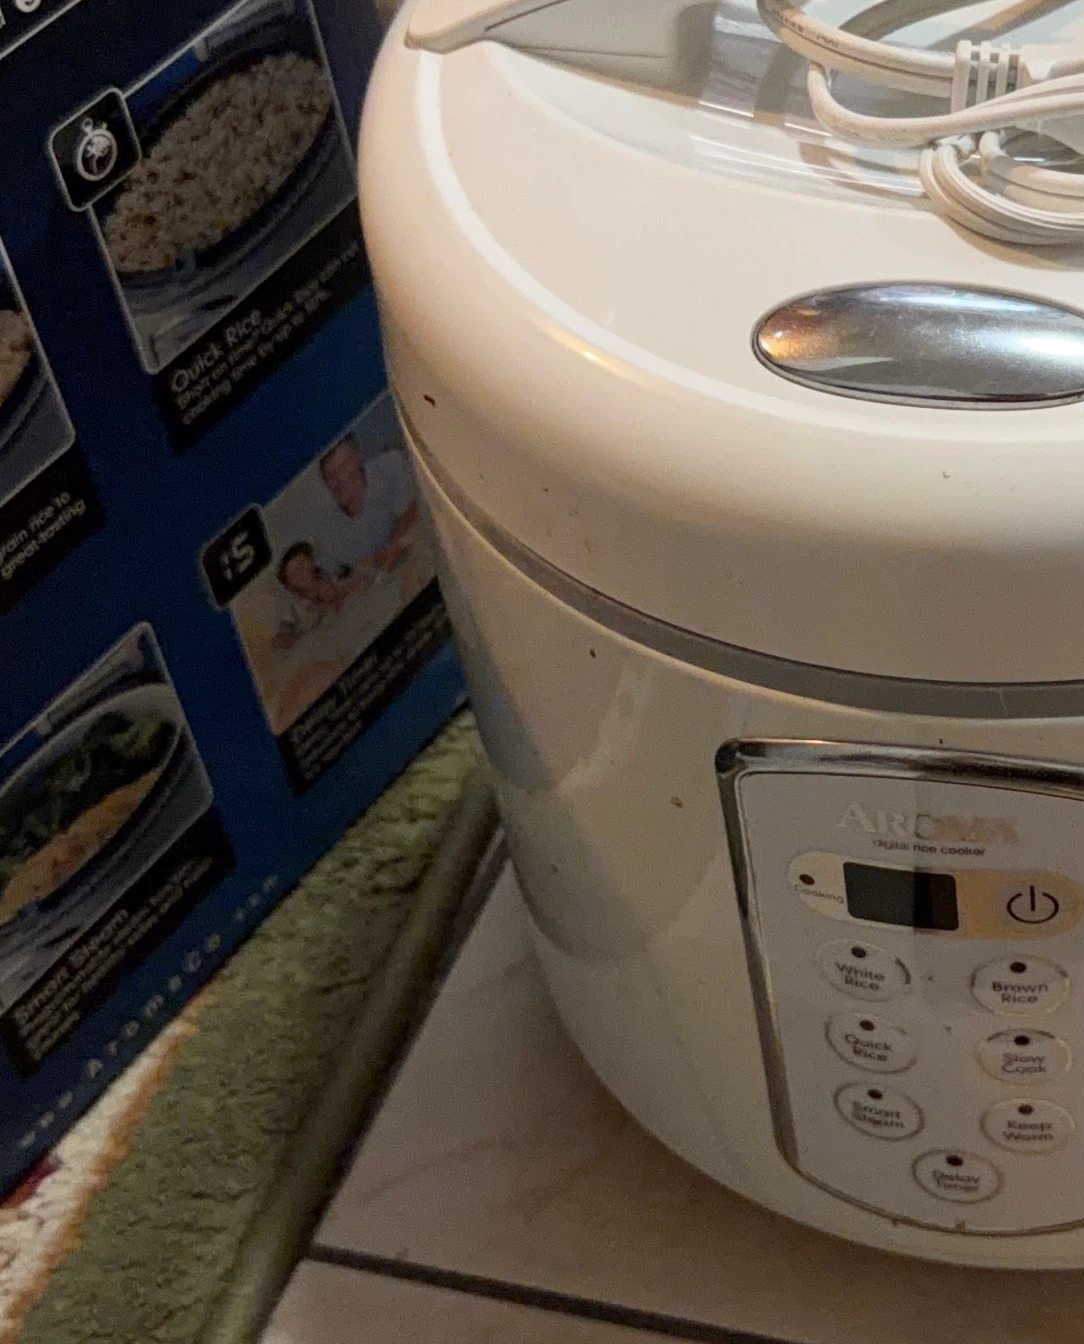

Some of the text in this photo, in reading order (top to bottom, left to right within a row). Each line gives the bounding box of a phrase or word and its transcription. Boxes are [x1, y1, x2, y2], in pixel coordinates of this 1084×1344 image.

[170, 307, 262, 394] Quick Rice
[794, 882, 846, 906] Cooking
[834, 960, 886, 983] White
[843, 975, 880, 993] Rice
[991, 980, 1049, 994] Brown
[1000, 991, 1039, 1005] Rice
[844, 1032, 894, 1053] Quick
